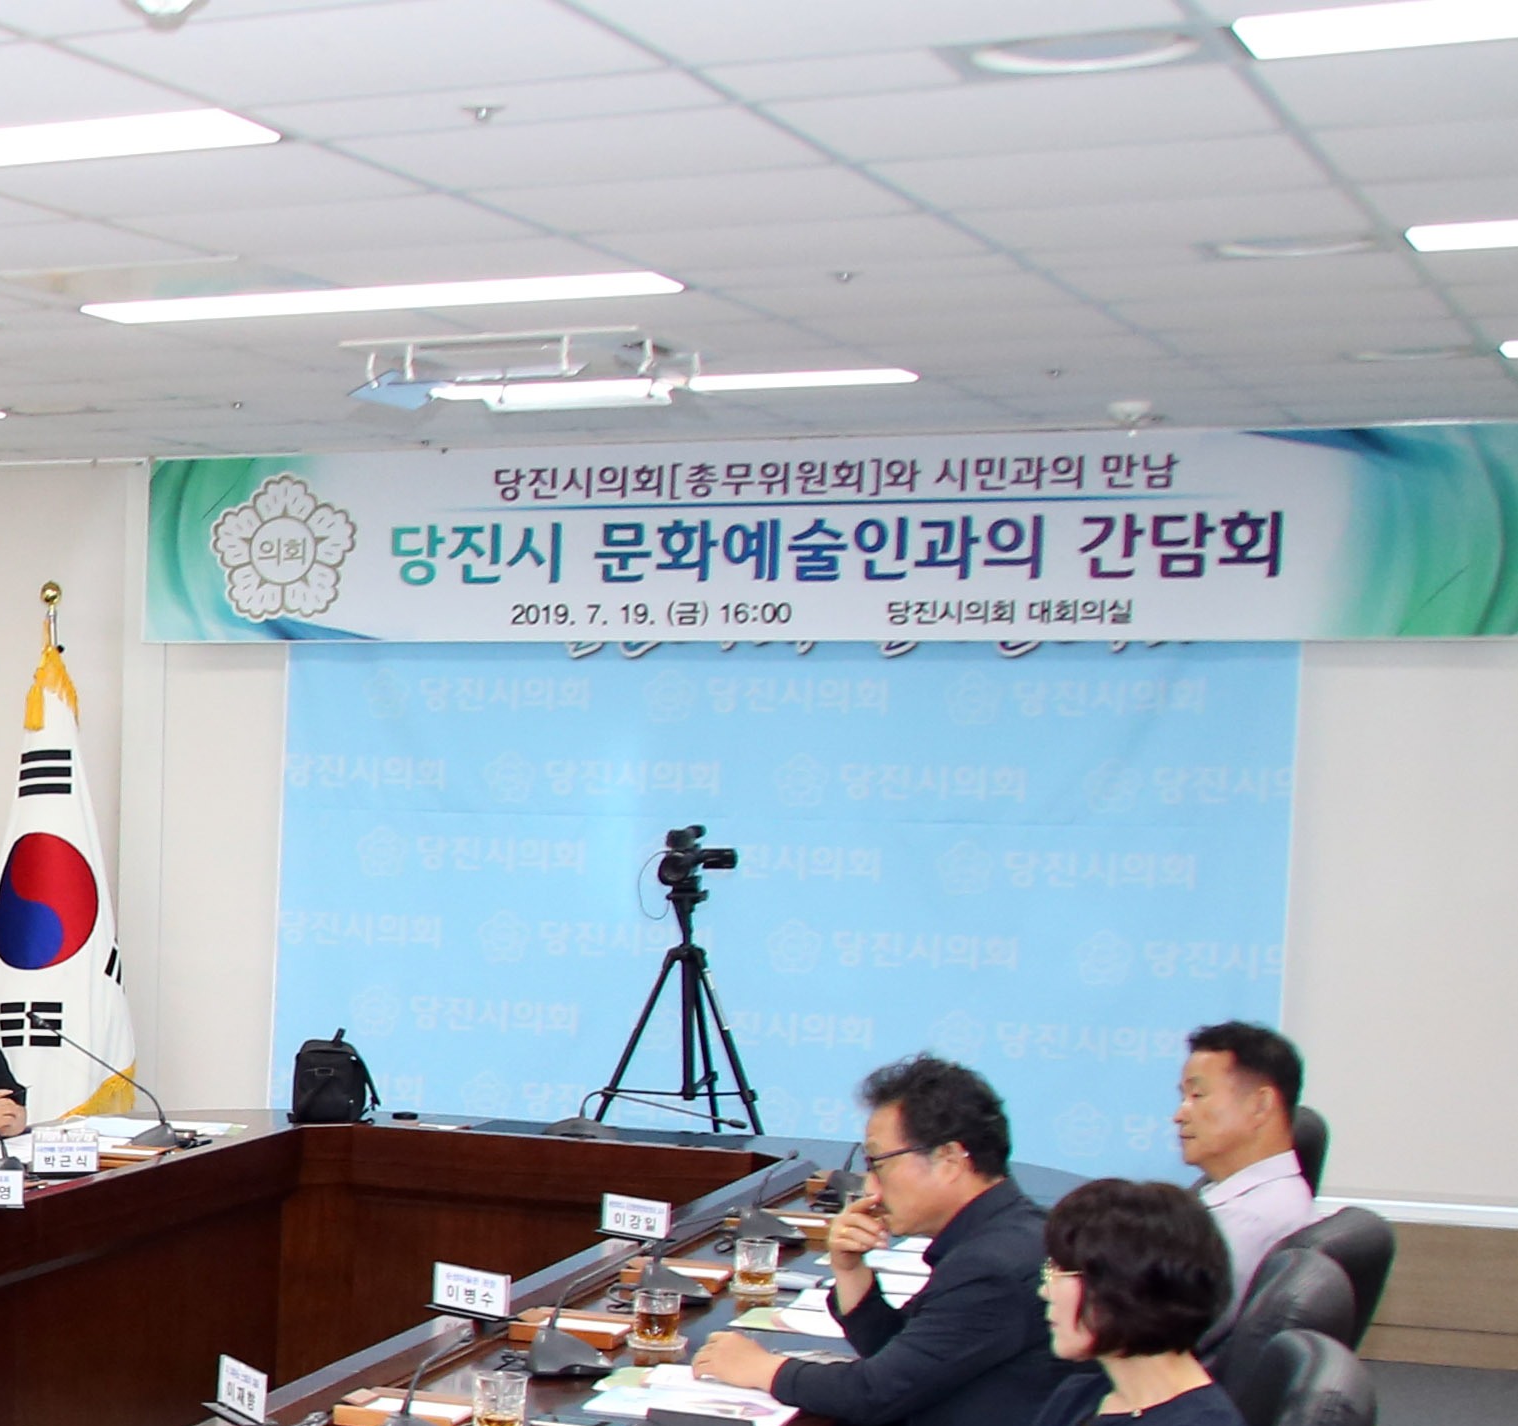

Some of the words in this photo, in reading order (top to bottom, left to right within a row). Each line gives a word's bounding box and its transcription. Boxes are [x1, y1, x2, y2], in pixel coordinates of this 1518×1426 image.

[493, 459, 922, 502] 당진시의회[총무위원회]와
[934, 454, 1085, 495] 시민과의
[1101, 452, 1180, 490] 만남
[257, 538, 307, 567] 의회
[390, 521, 562, 586] 당진시
[594, 513, 1045, 583] 문화예술인과의
[1078, 510, 1284, 580] 간담회
[511, 602, 575, 627] 2019.
[587, 603, 608, 627] 7.
[621, 602, 655, 626] 19.
[667, 600, 709, 627] (금)
[719, 601, 793, 626] 16:00
[887, 600, 1017, 625] 당진시의회
[1028, 599, 1133, 625] 대회의실
[418, 674, 591, 712] 당진시의회
[706, 676, 890, 716] 당진시의회
[1011, 677, 1206, 717] 당진시의회
[284, 752, 446, 791] 당진시의회
[543, 758, 721, 796] 당진시의회
[838, 764, 1030, 803] 당진시의회
[416, 833, 587, 873] 당진시의회
[737, 844, 883, 886] 진시의회
[1003, 848, 1196, 890] 당진시의회
[280, 911, 443, 950] 당진시의회
[831, 930, 1021, 972] 당진시의회
[409, 996, 580, 1036] 당진시의회
[729, 1010, 874, 1051] 진시의회
[996, 1020, 1186, 1064] 당진시의회
[614, 1211, 657, 1232] 이강일
[446, 1284, 495, 1308] 이병수
